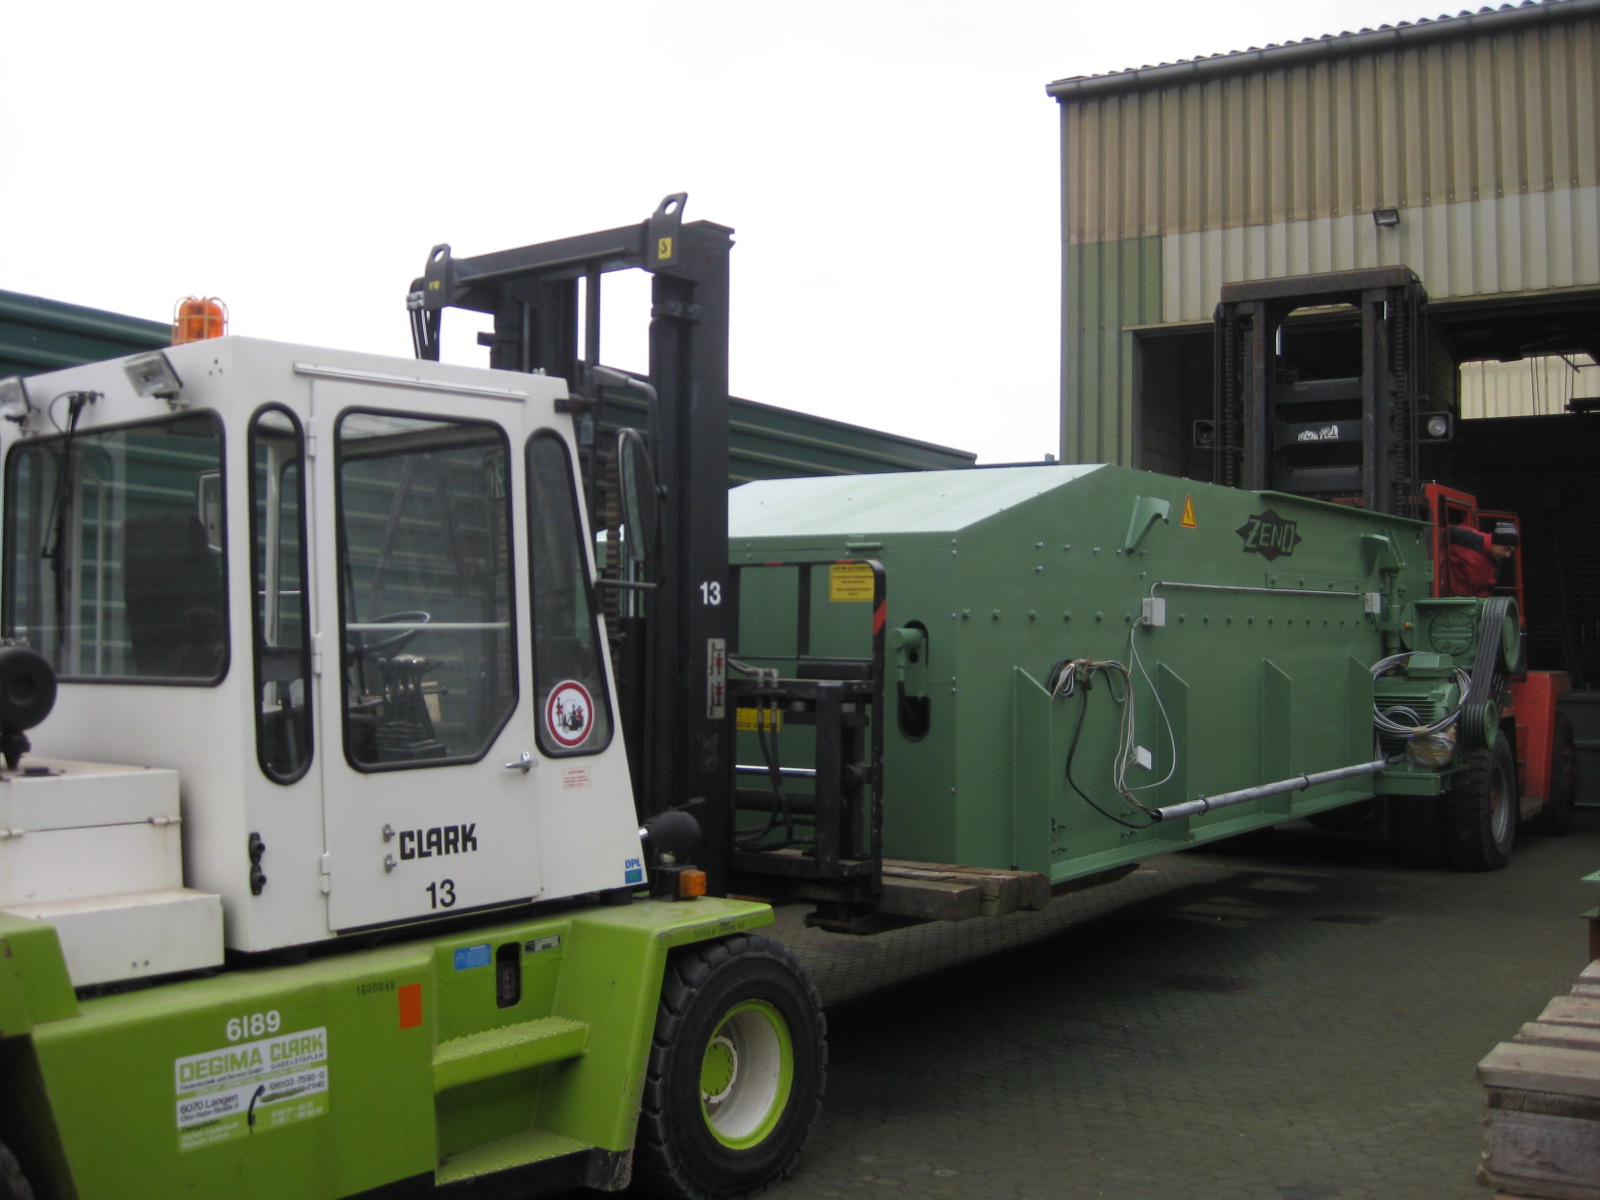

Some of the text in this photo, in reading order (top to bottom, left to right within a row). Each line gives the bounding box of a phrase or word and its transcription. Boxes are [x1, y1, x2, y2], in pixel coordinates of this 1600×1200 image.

[1245, 518, 1296, 553] ZENO
[700, 581, 721, 605] 13
[400, 823, 477, 860] CLARK
[625, 859, 641, 869] DPL
[426, 879, 456, 909] 13
[226, 1010, 281, 1041] 6189
[179, 1033, 322, 1083] DEGIMA CLARK
[271, 1052, 323, 1069] GABELSTAPLER
[180, 1094, 238, 1114] 6070 Langen
